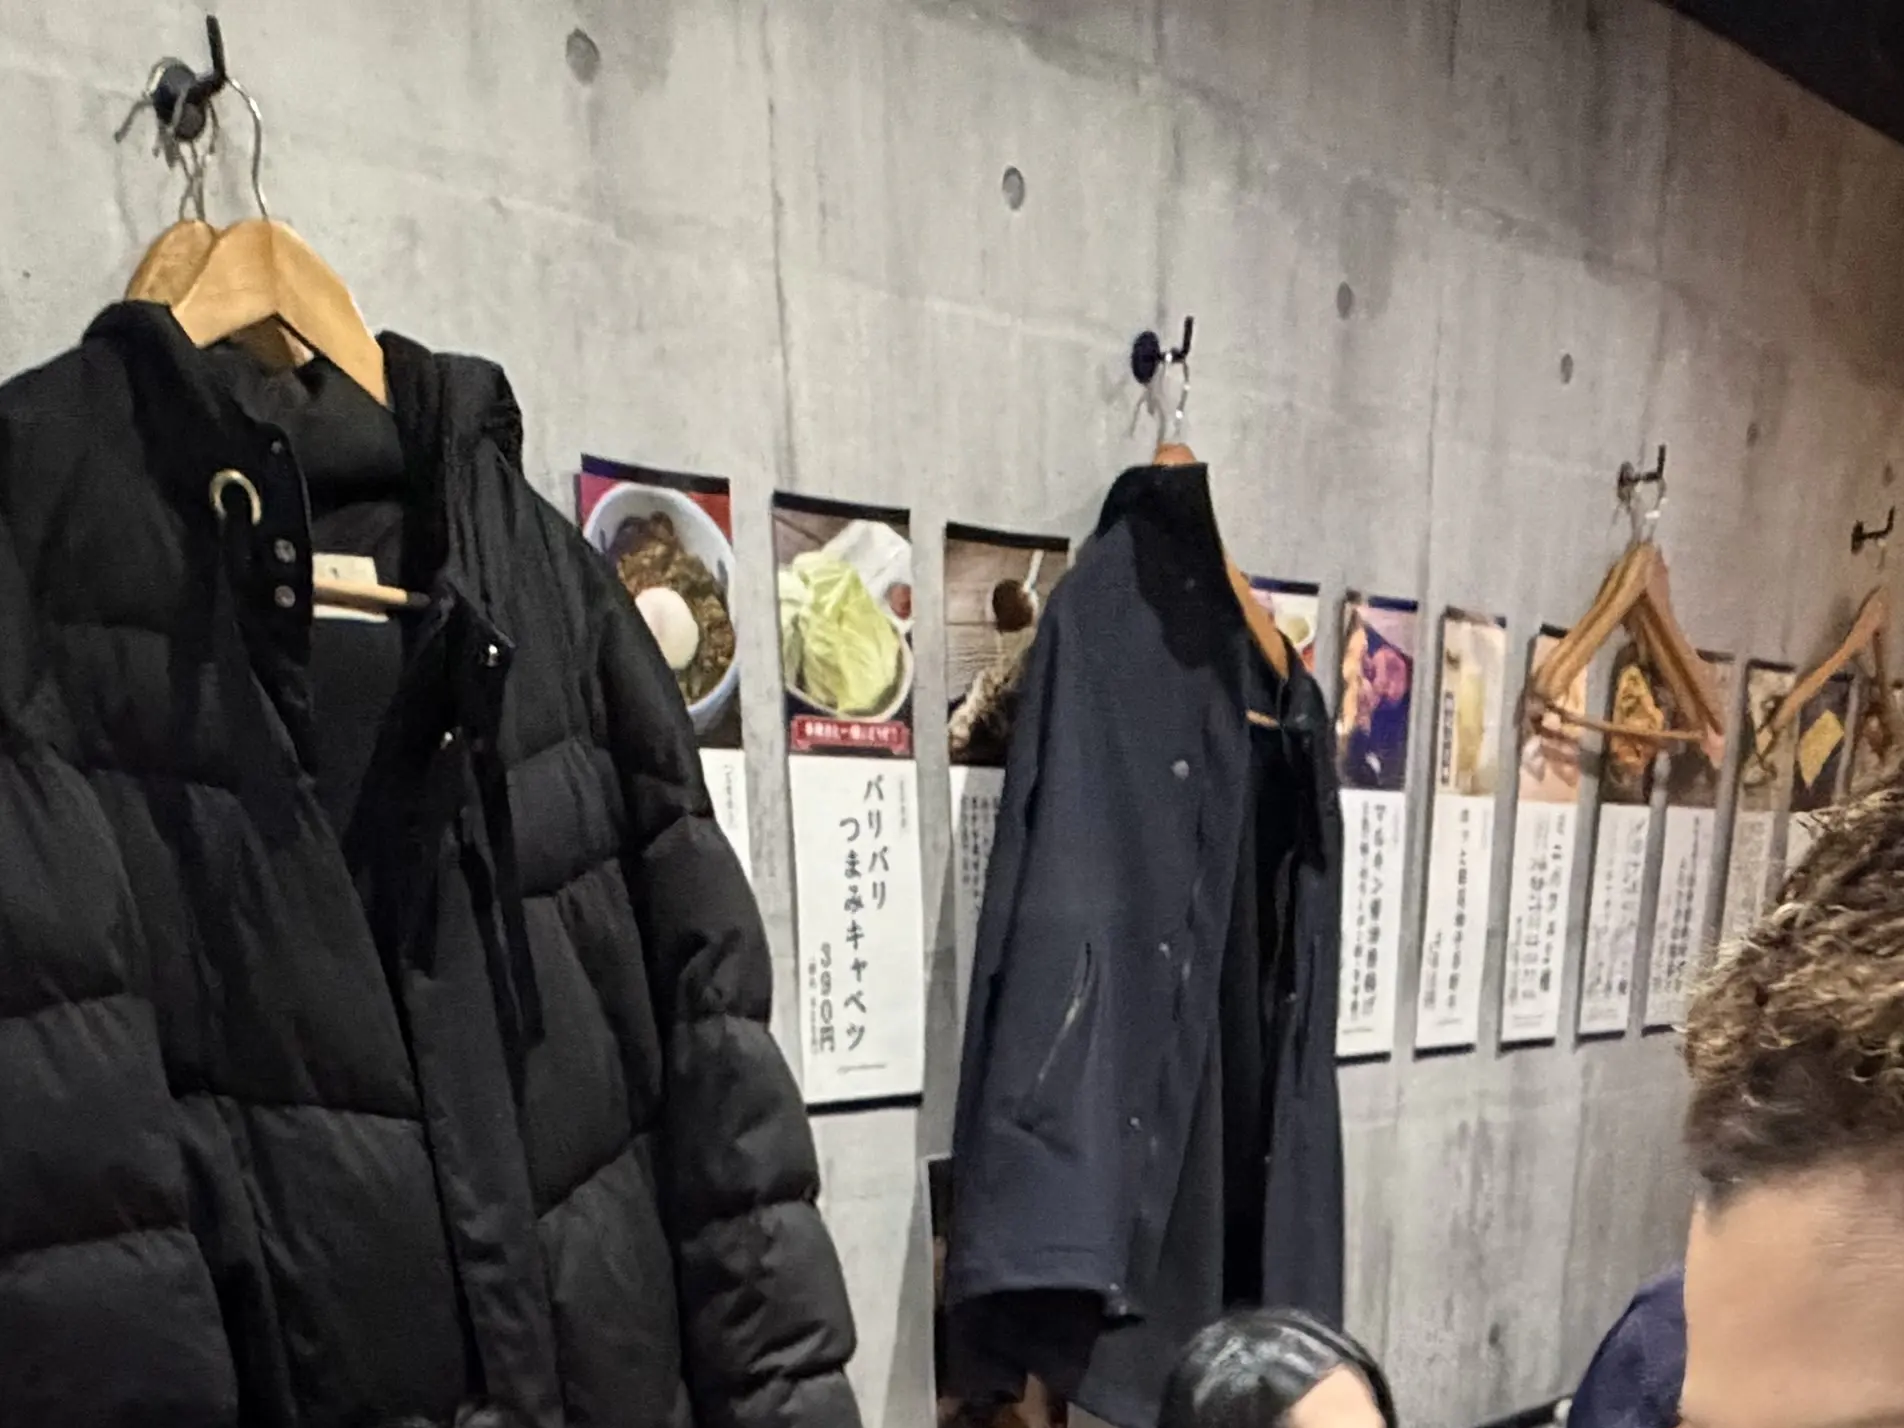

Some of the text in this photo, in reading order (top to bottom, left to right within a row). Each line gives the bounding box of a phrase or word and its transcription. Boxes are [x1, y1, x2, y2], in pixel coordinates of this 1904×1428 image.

[839, 816, 869, 1052] つまみキャベツ
[863, 774, 890, 910] パリパリ
